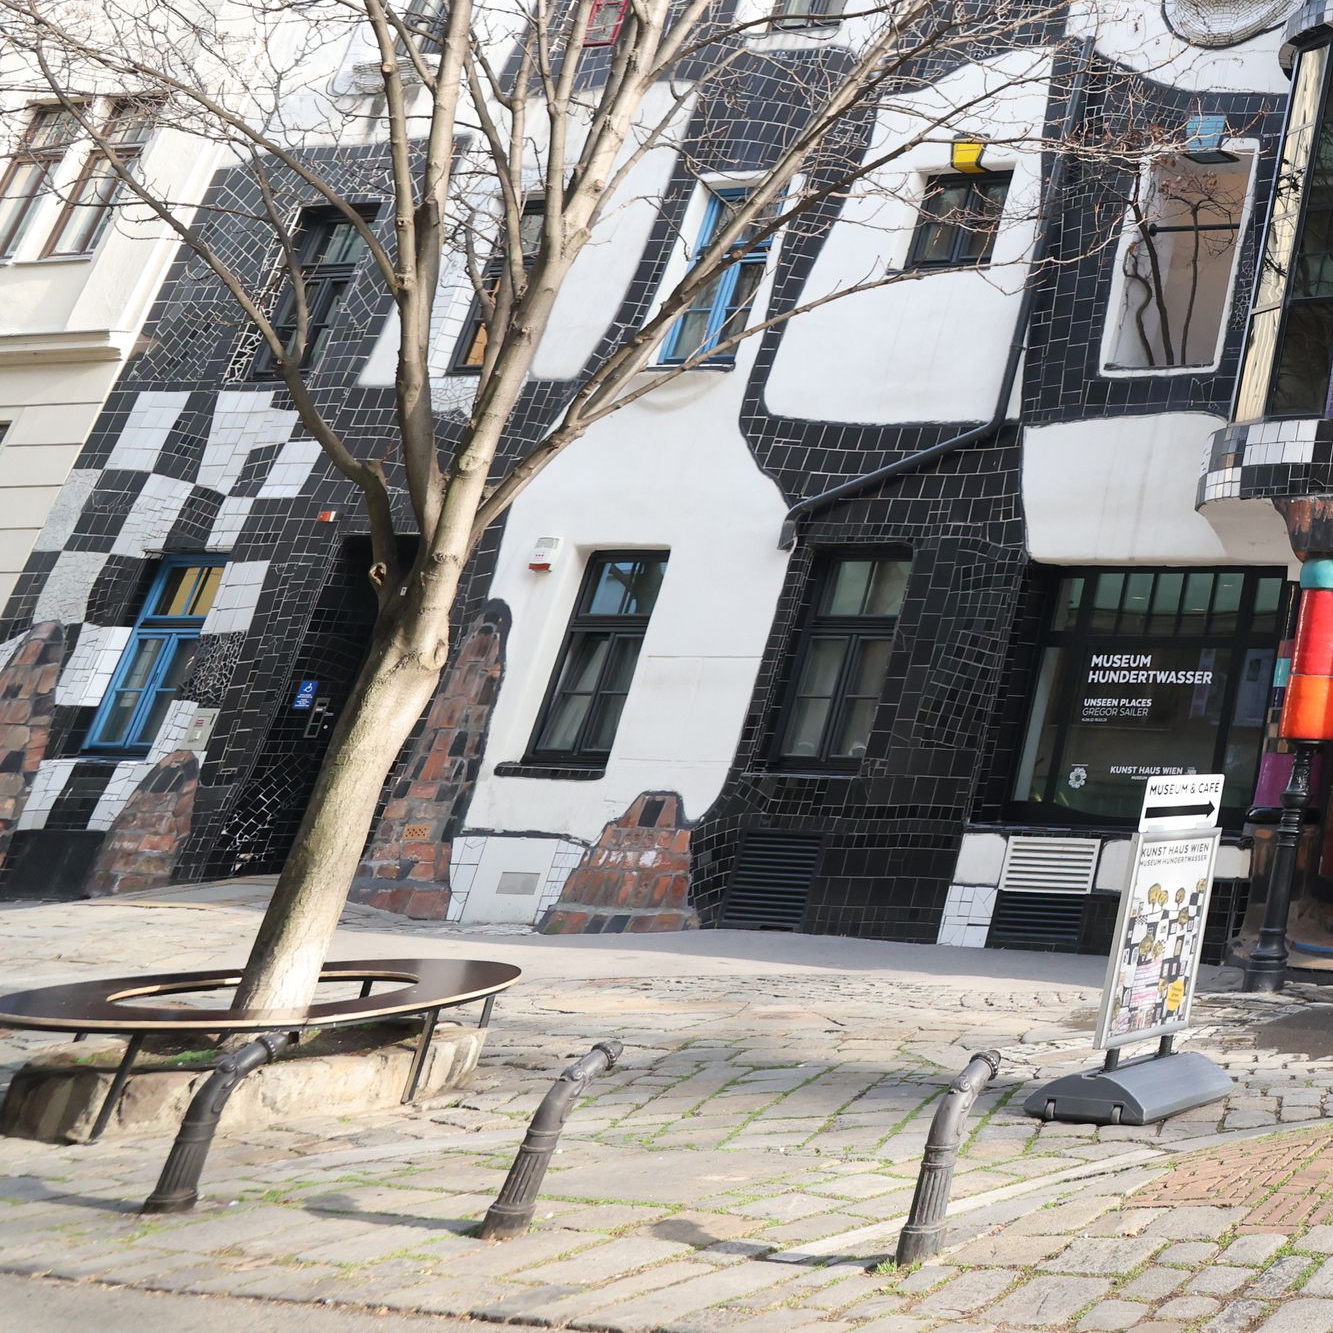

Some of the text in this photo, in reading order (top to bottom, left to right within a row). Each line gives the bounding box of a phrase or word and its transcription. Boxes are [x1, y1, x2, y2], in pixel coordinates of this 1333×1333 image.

[1091, 654, 1152, 668] MUSEUM
[1088, 670, 1213, 684] HUNDERTWASSER
[1084, 698, 1152, 707] UNSEEN PLACES
[1082, 707, 1149, 717] GREGOR SAILER
[1110, 765, 1137, 774] KUNST
[1138, 766, 1160, 775] HAUS
[1162, 766, 1183, 775] WIEN
[1149, 779, 1220, 796] MUSEUM & CAFÉ
[1140, 843, 1209, 858] KUNST HAUS WIEN
[1139, 855, 1207, 867] MUSEUM HUNDERTWASSER
